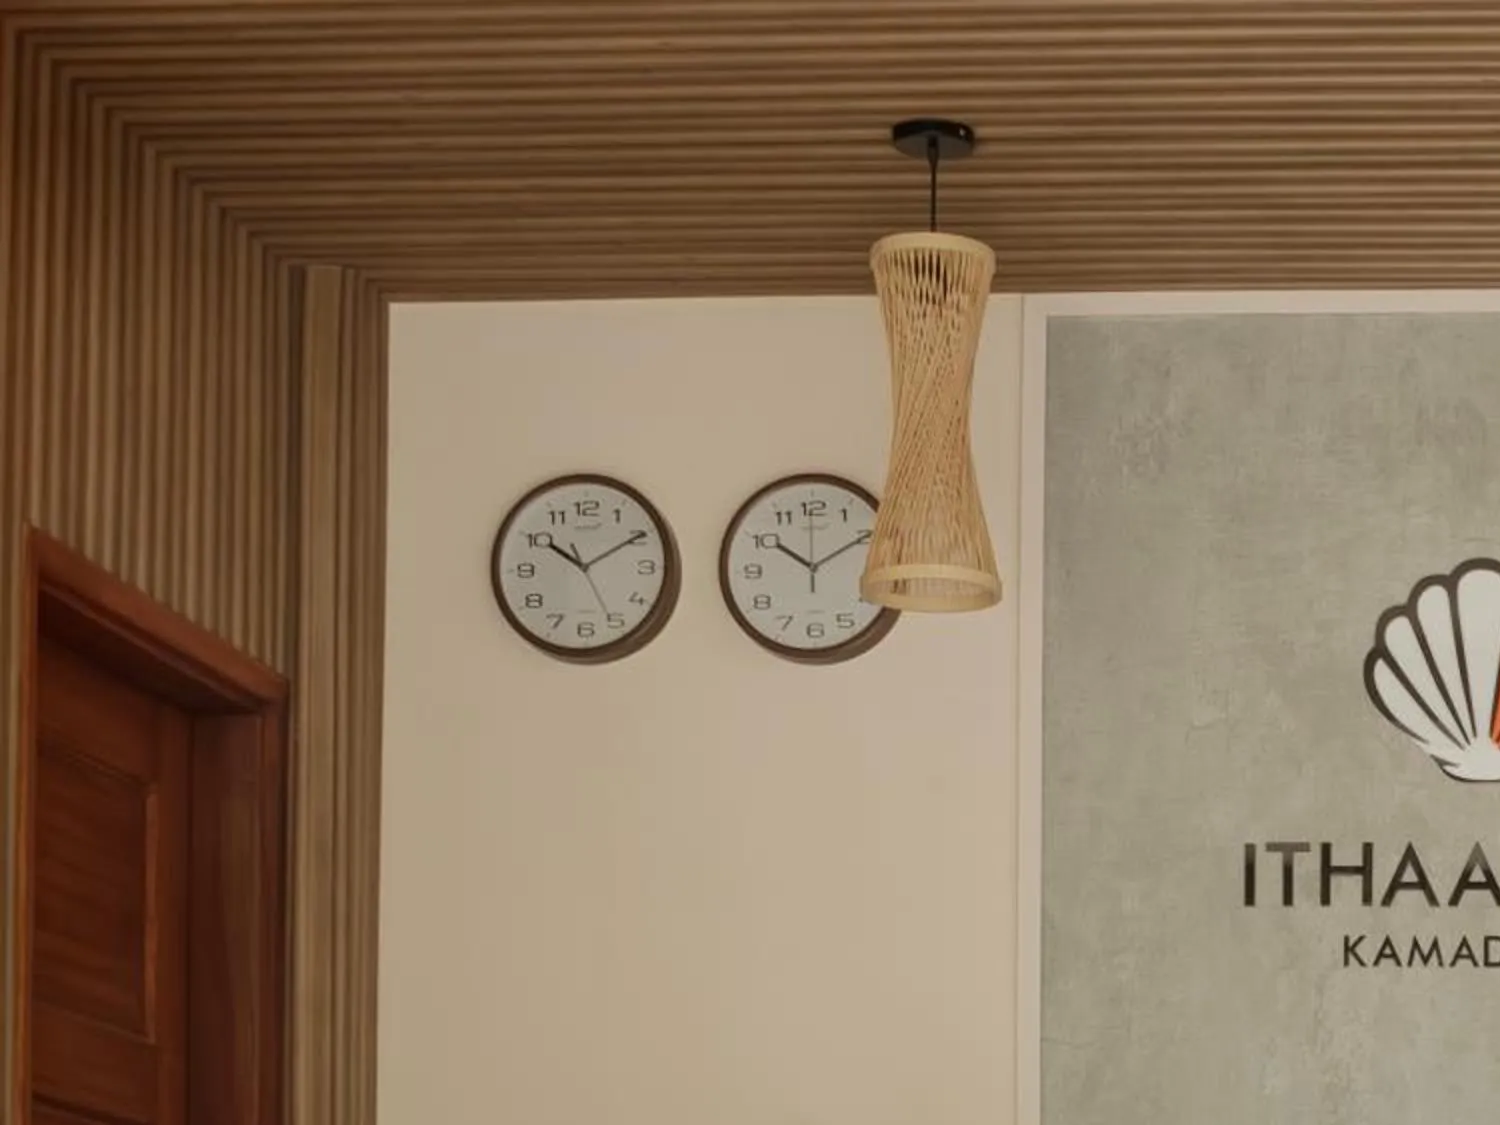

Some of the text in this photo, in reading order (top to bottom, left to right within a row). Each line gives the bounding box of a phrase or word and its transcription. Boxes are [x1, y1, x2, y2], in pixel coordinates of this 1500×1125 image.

[573, 501, 600, 516] 12
[801, 501, 827, 516] 12
[841, 508, 847, 522] 1
[548, 511, 565, 525] 11
[613, 509, 621, 524] 1
[775, 511, 792, 525] 11
[527, 532, 553, 548] 10
[629, 530, 647, 545] 2
[753, 534, 779, 549] 10
[856, 530, 873, 544] 2
[517, 563, 534, 578] 9
[637, 560, 655, 575] 3
[744, 564, 762, 579] 9
[525, 593, 543, 608] 8
[629, 592, 644, 605] 4
[754, 595, 771, 610] 8
[547, 614, 564, 629] 7
[607, 613, 625, 629] 5
[775, 615, 793, 631] 7
[836, 613, 855, 629] 5
[577, 623, 595, 637] 6
[807, 623, 824, 638] 6
